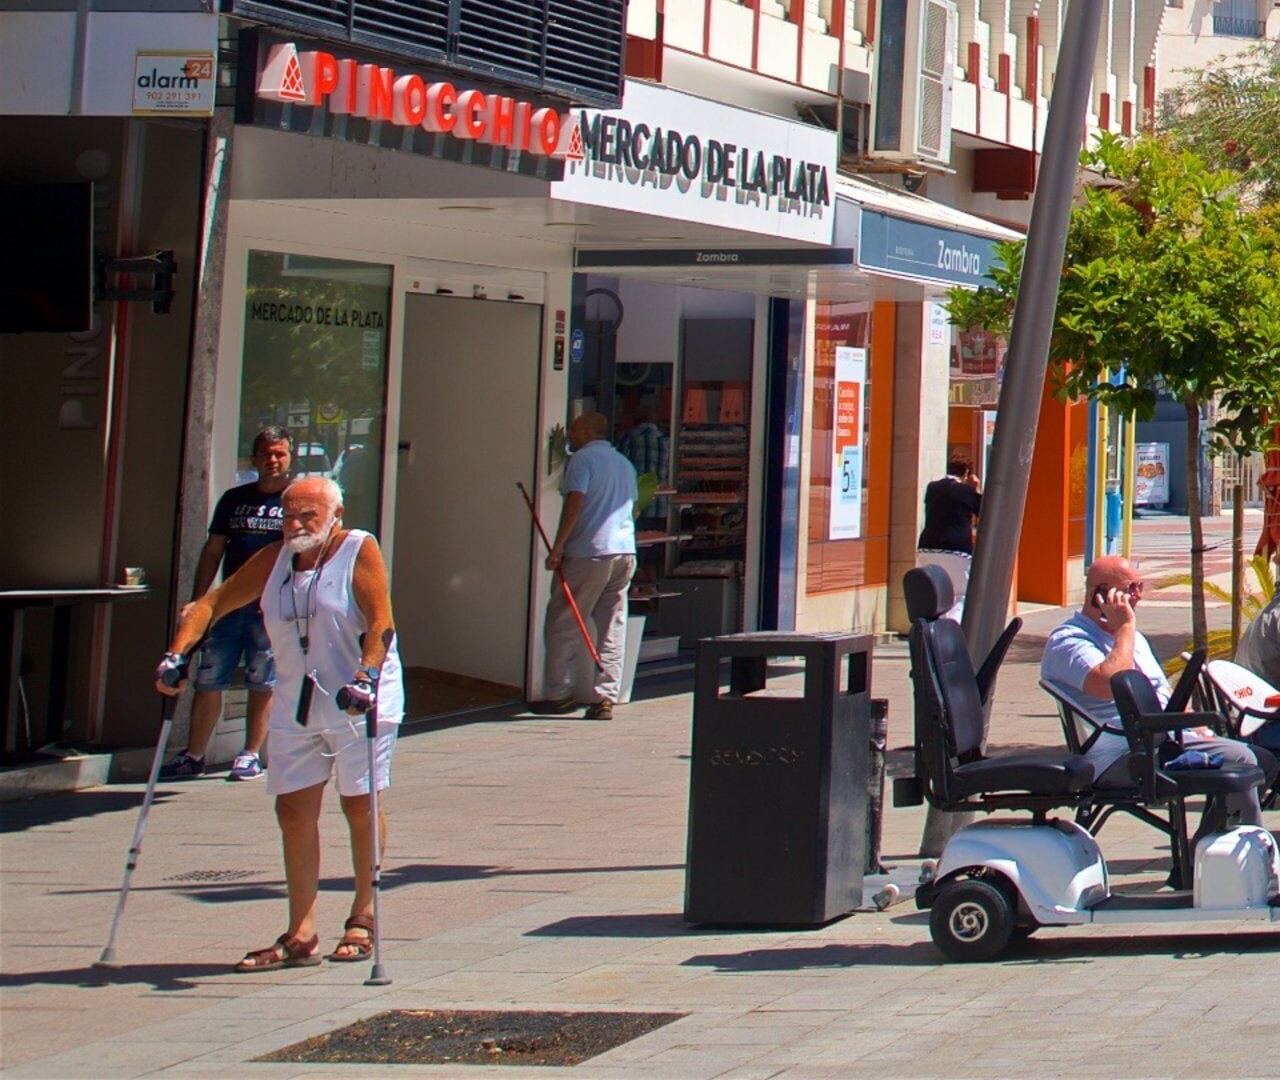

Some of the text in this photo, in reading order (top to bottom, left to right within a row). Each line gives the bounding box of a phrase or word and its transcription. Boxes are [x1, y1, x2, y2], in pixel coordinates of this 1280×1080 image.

[137, 67, 198, 88] alarm
[298, 51, 562, 156] PINOCCHIO
[580, 110, 830, 207] MERCADO DE LA PLATA
[696, 251, 739, 263] Zambra
[937, 239, 981, 275] Zambra
[252, 302, 385, 329] MERCADO DE LA PLATA
[842, 460, 850, 493] 5
